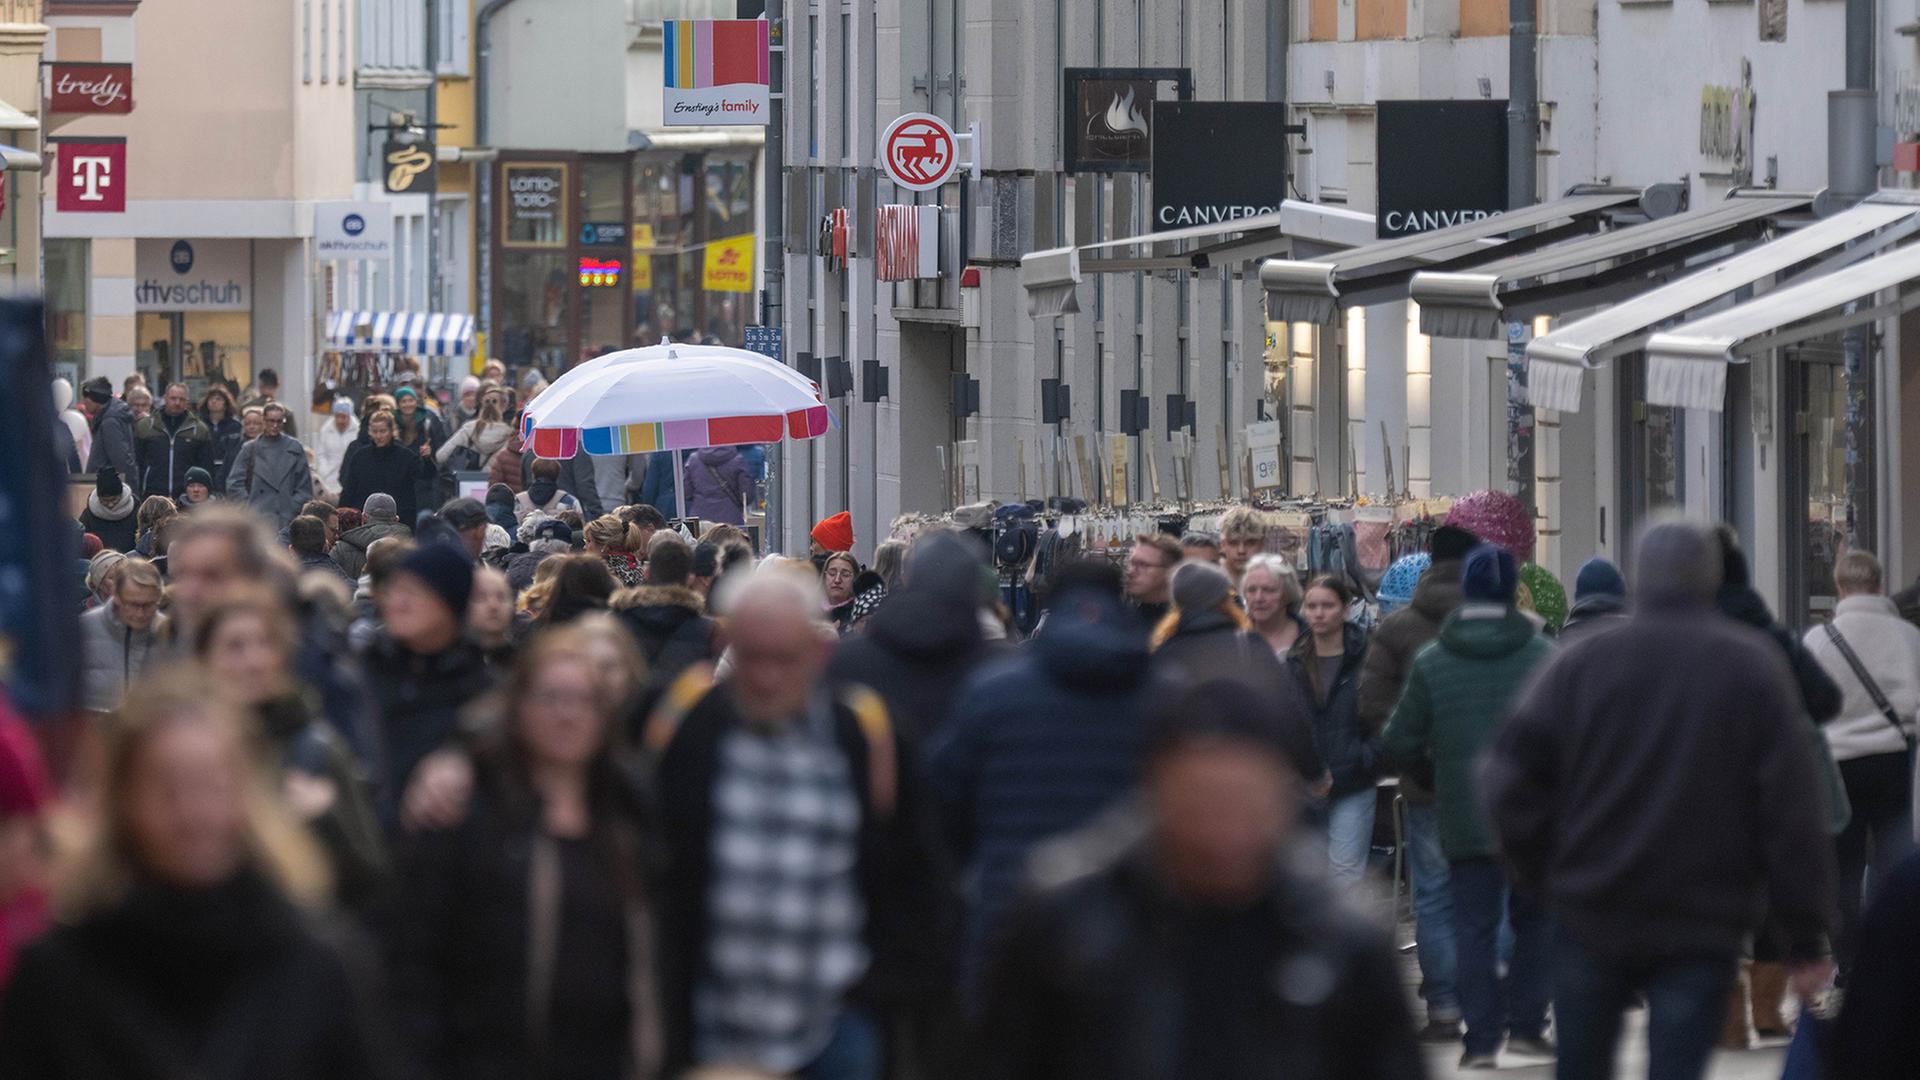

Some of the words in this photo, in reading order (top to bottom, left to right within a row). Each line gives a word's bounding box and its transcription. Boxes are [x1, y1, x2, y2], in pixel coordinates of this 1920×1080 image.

[56, 73, 127, 106] tredy
[674, 101, 719, 116] Ernsting's
[721, 99, 759, 114] family
[1385, 210, 1504, 231] CANVER
